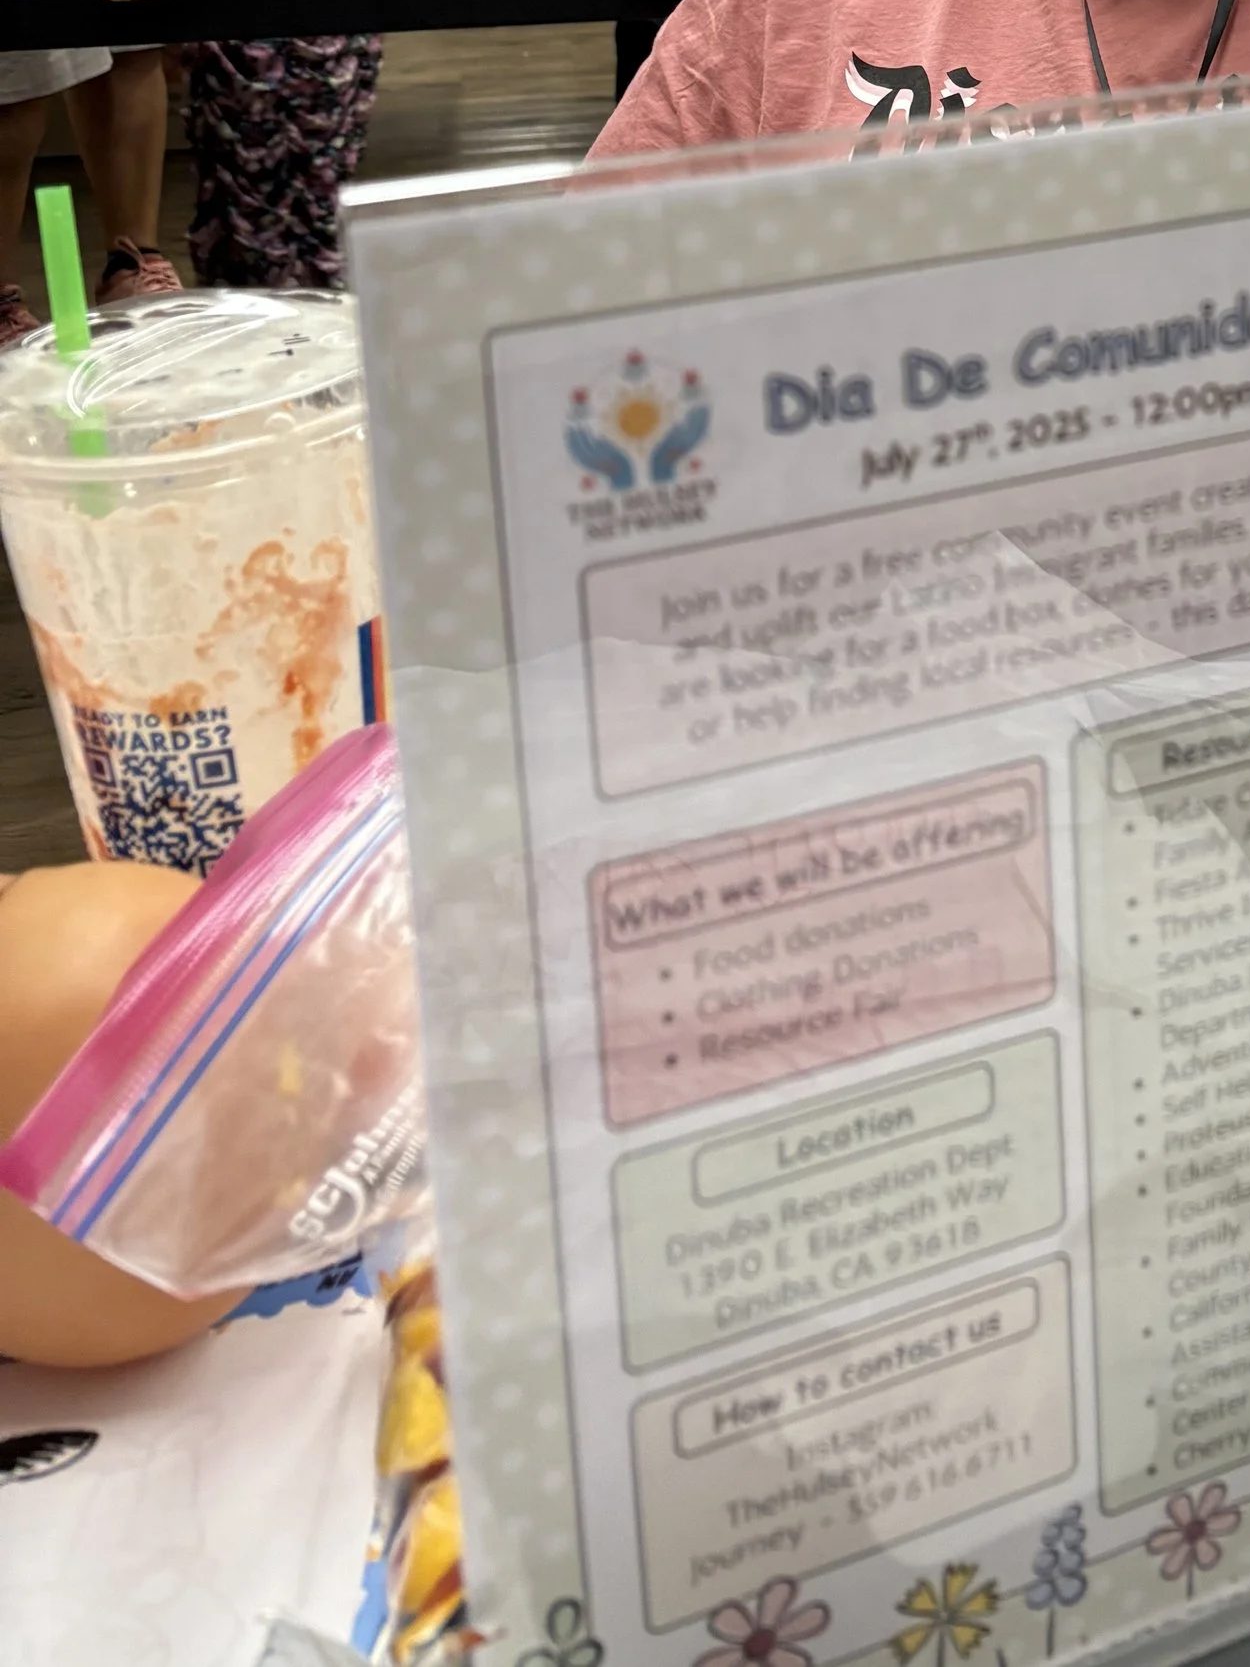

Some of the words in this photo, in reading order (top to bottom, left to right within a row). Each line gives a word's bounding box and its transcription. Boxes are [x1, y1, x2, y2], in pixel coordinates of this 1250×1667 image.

[764, 367, 875, 433] Dia
[905, 348, 987, 409] De
[860, 441, 920, 489] July
[1006, 405, 1090, 451] 2025
[132, 713, 161, 728] TO
